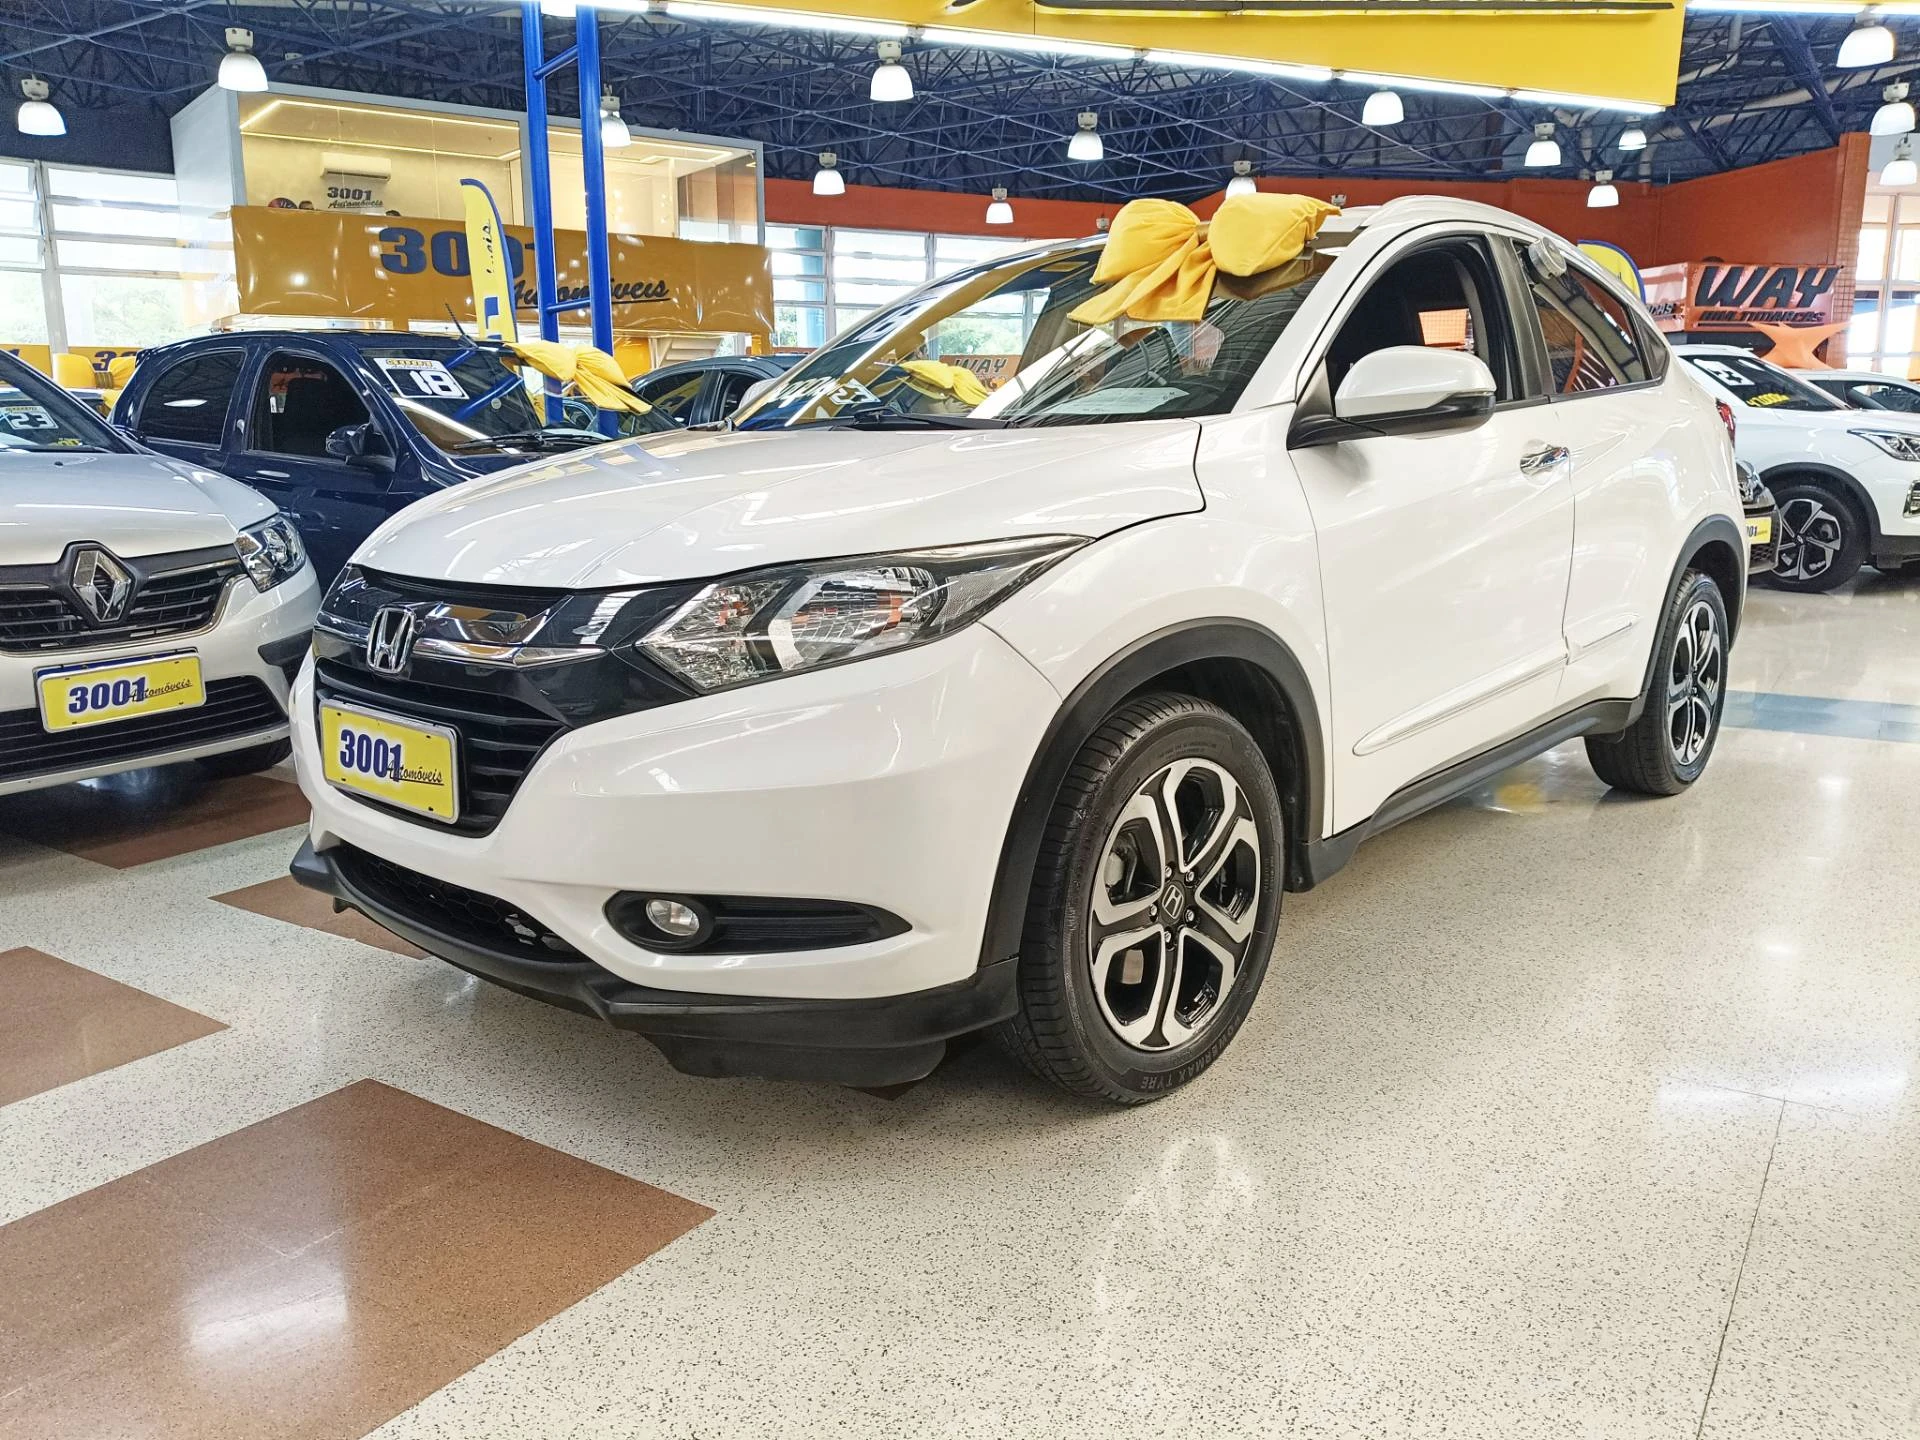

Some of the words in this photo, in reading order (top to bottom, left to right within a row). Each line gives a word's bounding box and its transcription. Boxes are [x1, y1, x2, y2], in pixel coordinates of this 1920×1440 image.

[327, 186, 372, 201] 3001
[1694, 265, 1840, 309] WAY
[68, 676, 146, 714] 3001
[339, 728, 402, 783] 3001
[1140, 1073, 1173, 1090] TYRE
